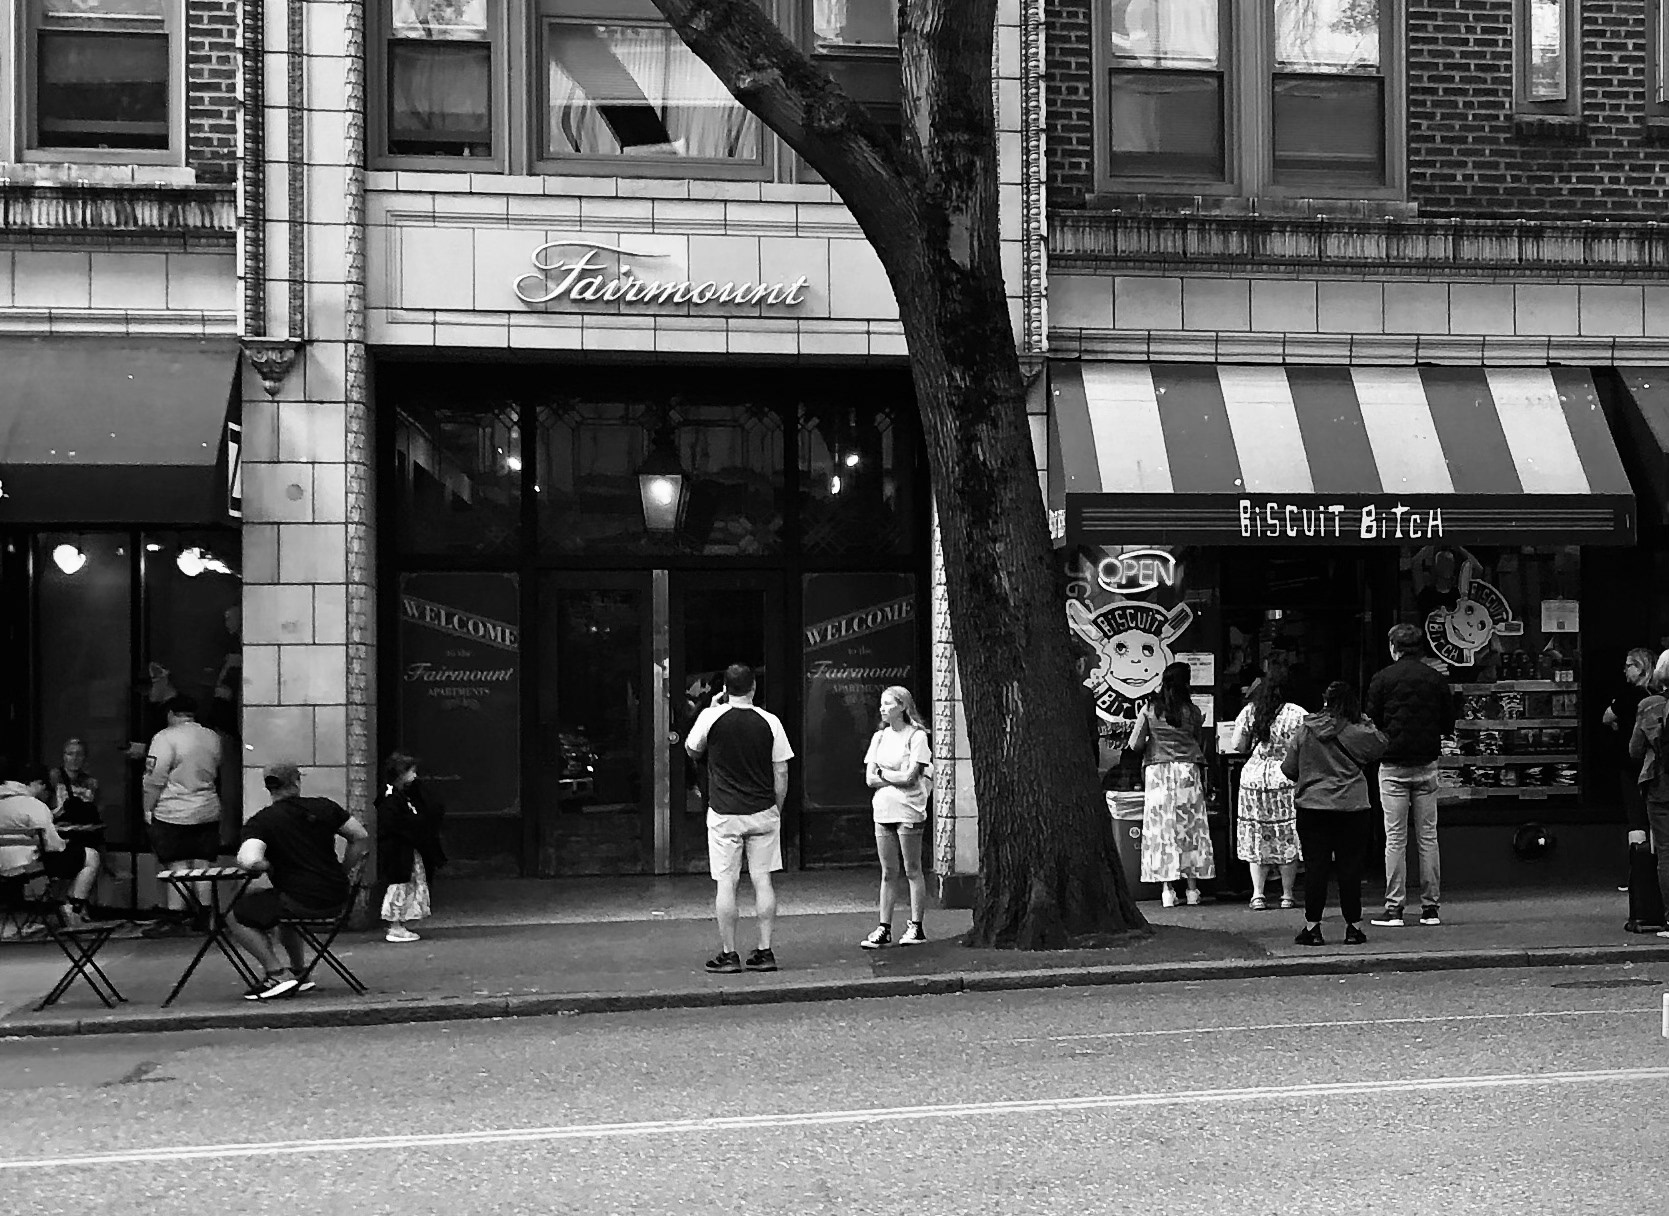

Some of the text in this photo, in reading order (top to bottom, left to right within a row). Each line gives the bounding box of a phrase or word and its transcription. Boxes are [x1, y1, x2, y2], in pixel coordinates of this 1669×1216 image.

[513, 240, 810, 305] Fairmount
[1098, 557, 1174, 586] OPEN
[403, 599, 518, 647] WELCOME
[805, 599, 914, 645] WELCOME
[404, 662, 514, 682] Fairmount
[806, 660, 911, 679] Fairmount
